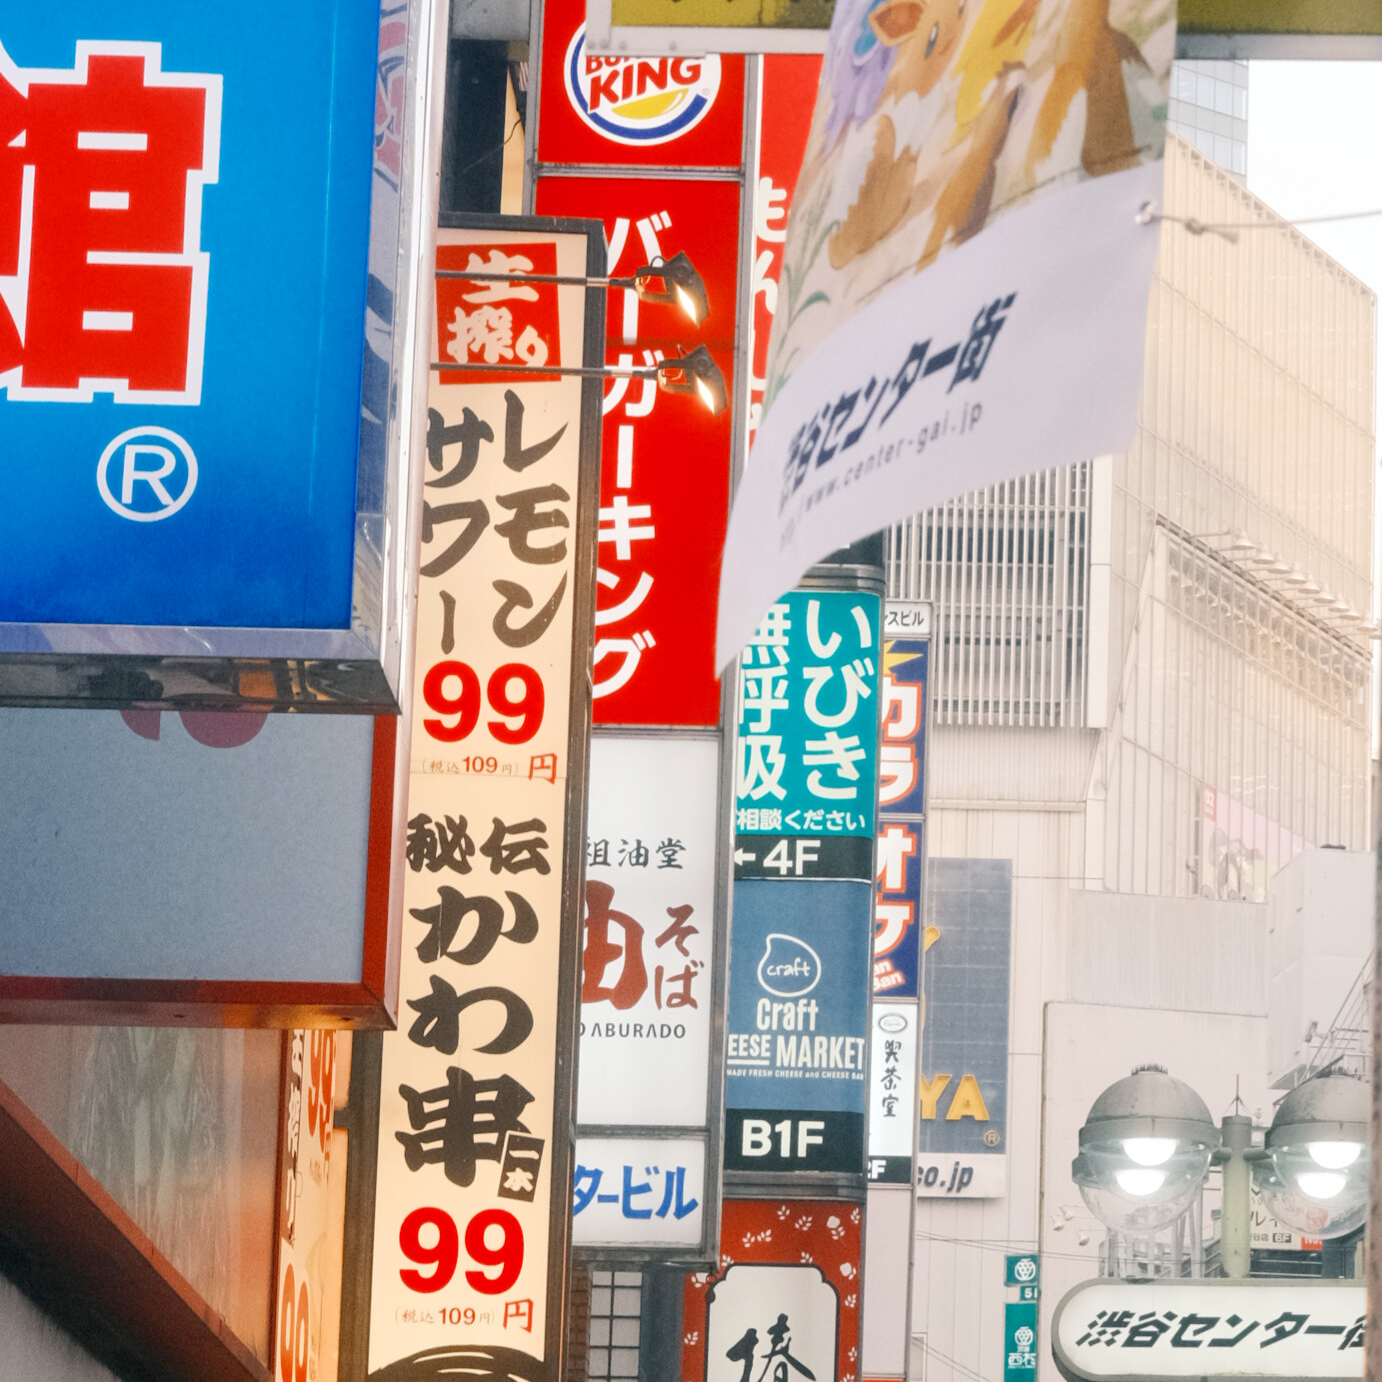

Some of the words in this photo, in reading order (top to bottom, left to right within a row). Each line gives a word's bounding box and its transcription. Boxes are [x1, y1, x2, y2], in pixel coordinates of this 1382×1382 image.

[587, 55, 703, 114] KING
[419, 406, 494, 655] サワー
[491, 388, 570, 649] レモン
[423, 660, 546, 746] 99
[803, 598, 875, 801] いびき
[527, 752, 558, 786] 円
[405, 813, 552, 876] 秘伝
[763, 839, 822, 876] 4F
[654, 903, 705, 1011] そば
[766, 956, 811, 978] craft
[591, 1022, 687, 1039] ABURADO
[757, 998, 819, 1031] Craft
[775, 1070, 804, 1080] CHEESE
[821, 1071, 850, 1081] CHEESE
[776, 1036, 865, 1070] MARKET
[881, 1039, 902, 1118] 喫茶室
[742, 1119, 826, 1158] B1F
[399, 1206, 526, 1296] 99
[502, 1297, 535, 1334] 円
